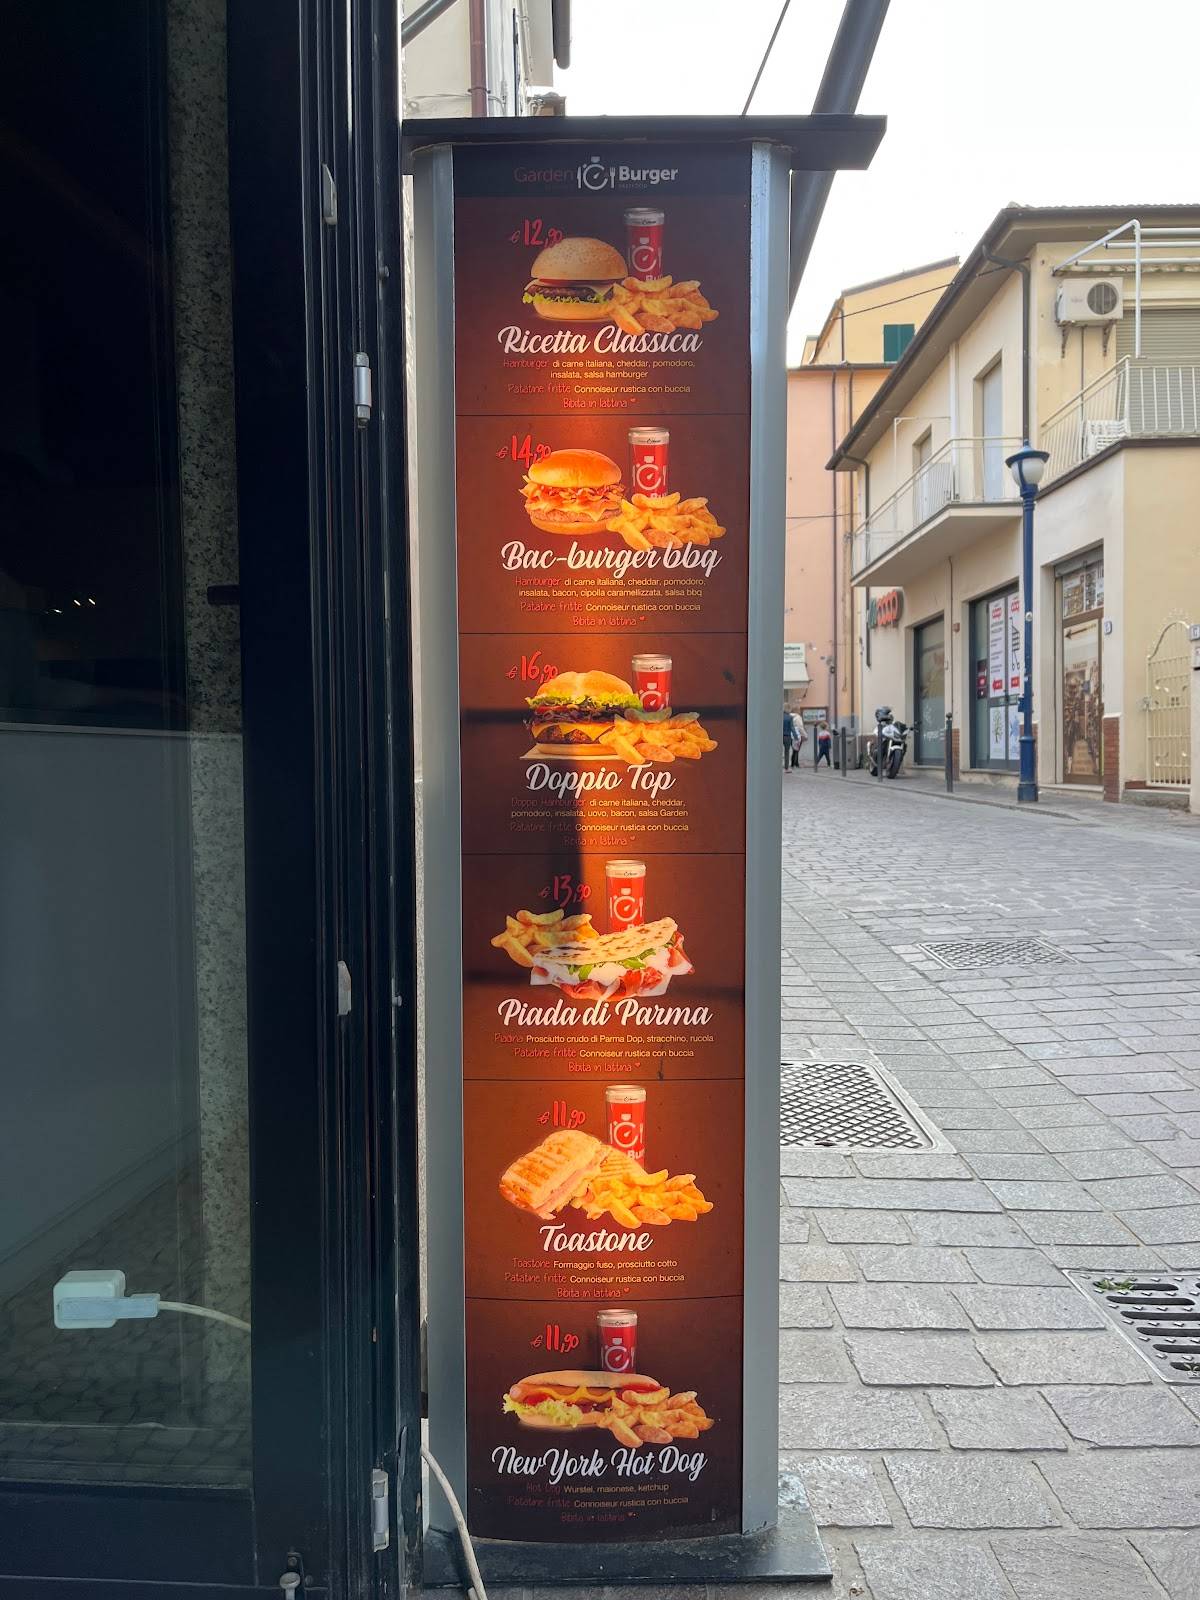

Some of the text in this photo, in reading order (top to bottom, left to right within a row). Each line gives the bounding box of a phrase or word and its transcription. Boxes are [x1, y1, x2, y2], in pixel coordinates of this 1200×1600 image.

[514, 166, 678, 185] Garden Burger
[524, 219, 565, 248] 12,90
[497, 325, 703, 354] Ricetta Classica
[503, 359, 548, 369] Hamburger
[585, 360, 615, 369] italiana,
[617, 359, 650, 368] cheddar,
[653, 360, 695, 369] pomodoro,
[551, 371, 582, 379] insalata,
[606, 371, 648, 380] hamburger
[574, 385, 618, 393] Connoiseur
[620, 385, 646, 393] rustica
[665, 385, 691, 393] buccia
[588, 399, 598, 408] in
[600, 398, 627, 408] lattina
[511, 435, 551, 468] 14,90
[501, 541, 722, 578] Bac-burger bbq
[515, 577, 561, 586] Hamburger
[564, 578, 571, 586] di
[597, 578, 625, 587] italiana,
[627, 578, 662, 587] cheddar,
[664, 578, 706, 587] pomodoro,
[519, 589, 550, 597] insalata,
[552, 589, 578, 597] bacon,
[581, 589, 605, 598] cipolla
[607, 589, 662, 597] caramellizzata,
[687, 589, 702, 597] bbq
[520, 602, 556, 612] Patatine
[559, 601, 583, 612] fritte
[586, 603, 630, 611] Connoiseur
[631, 603, 657, 611] rustica
[675, 603, 701, 611] buccia
[609, 616, 637, 626] lattina
[521, 651, 559, 683] 16,90
[525, 762, 676, 799] Doppio Top
[621, 799, 650, 808] italiana,
[652, 799, 686, 807] cheddar,
[511, 809, 688, 818] pomodoro, insalata, uovo, bacon, salsa Garden
[664, 823, 688, 831] buccia
[553, 875, 592, 907] 13,90
[498, 998, 713, 1026] Piada di Parma
[526, 1035, 564, 1043] Prosciutto
[647, 1034, 688, 1042] stracchino,
[690, 1034, 714, 1042] rucola
[580, 1050, 624, 1058] Connoiseur
[625, 1050, 650, 1058] rustica
[604, 1062, 632, 1072] lattina
[553, 1101, 585, 1128] 11,90
[539, 1223, 653, 1252] Toastone
[512, 1258, 550, 1268] Toastone
[553, 1261, 594, 1270] Formaggio
[596, 1261, 615, 1270] fuso,
[618, 1260, 655, 1270] prosciutto
[570, 1275, 614, 1283] Connoiseur
[615, 1275, 641, 1283] rustica
[593, 1288, 621, 1298] lattina
[546, 1324, 579, 1352] 11,90
[492, 1446, 708, 1484] New York Hot Dog
[564, 1485, 594, 1494] Wurstel,
[596, 1485, 636, 1494] maionese,
[638, 1483, 669, 1492] ketchup
[574, 1499, 618, 1508] Connoiseur
[619, 1498, 645, 1507] rustica
[647, 1498, 662, 1506] con
[663, 1496, 688, 1505] buccia
